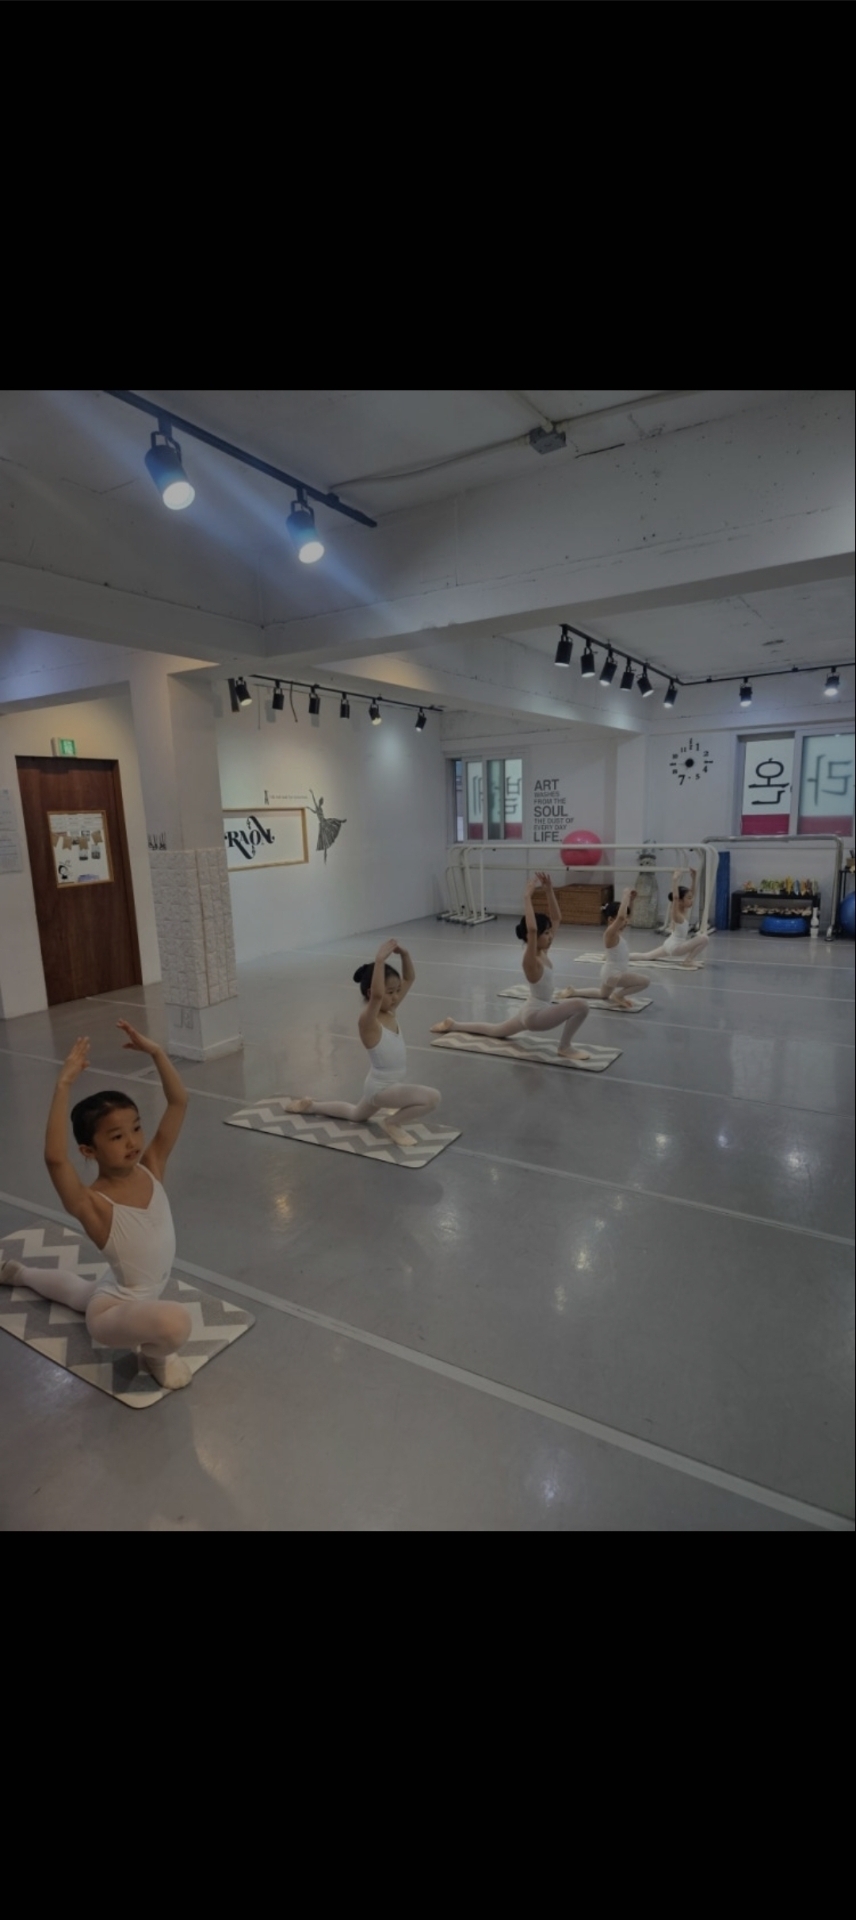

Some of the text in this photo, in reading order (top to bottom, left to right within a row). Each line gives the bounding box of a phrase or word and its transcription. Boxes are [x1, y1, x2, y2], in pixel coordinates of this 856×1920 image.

[534, 779, 559, 791] ART
[678, 774, 685, 785] 7
[534, 805, 568, 817] SOUL
[534, 831, 562, 842] LIFE.
